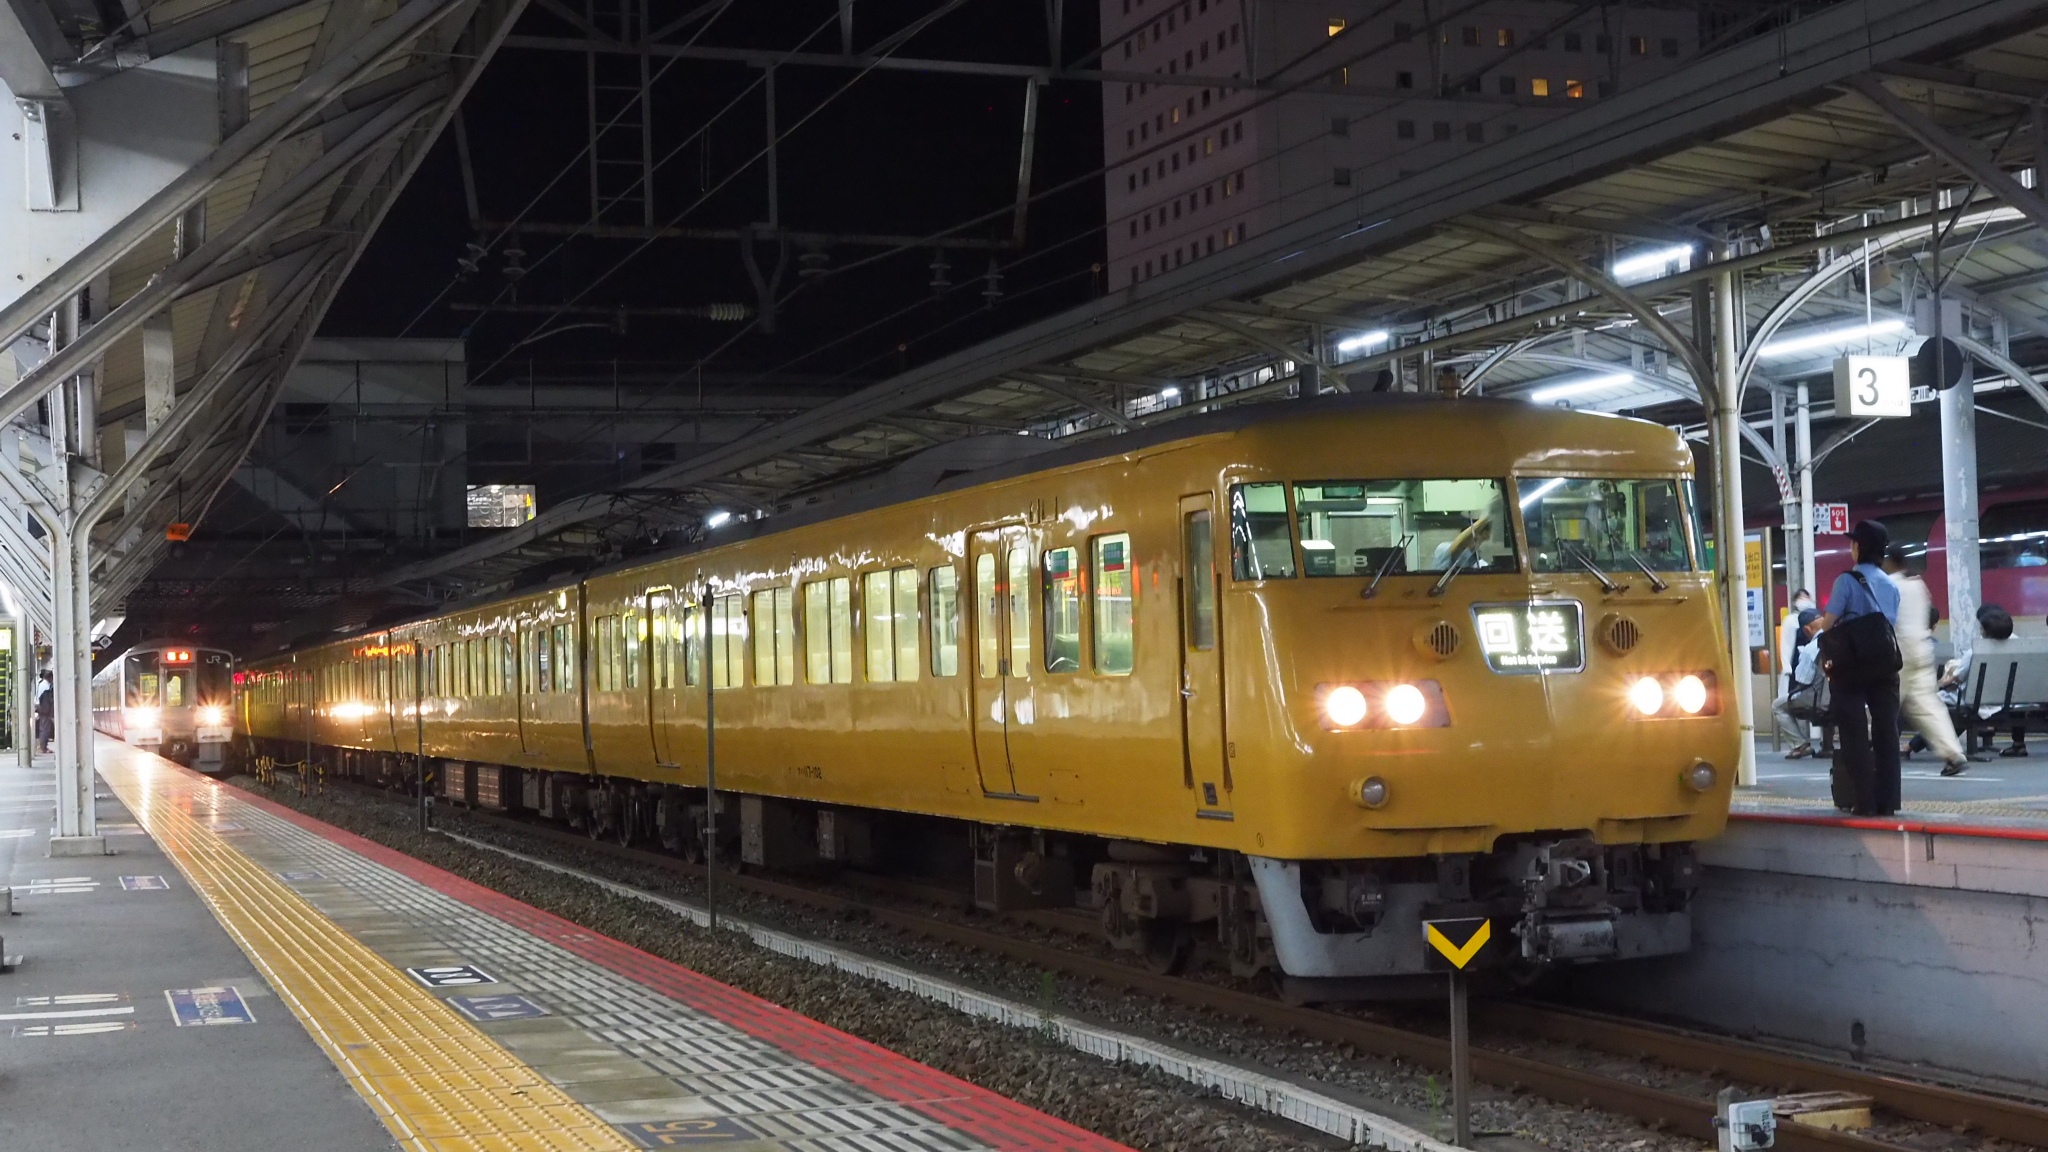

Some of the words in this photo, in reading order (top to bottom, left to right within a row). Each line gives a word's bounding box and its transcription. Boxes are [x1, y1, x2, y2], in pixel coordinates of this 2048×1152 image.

[1858, 367, 1879, 406] 3
[1831, 509, 1845, 517] SOS
[1477, 610, 1568, 655] 回送
[206, 655, 221, 664] JR
[1500, 655, 1517, 666] Not
[1527, 654, 1558, 666] Service
